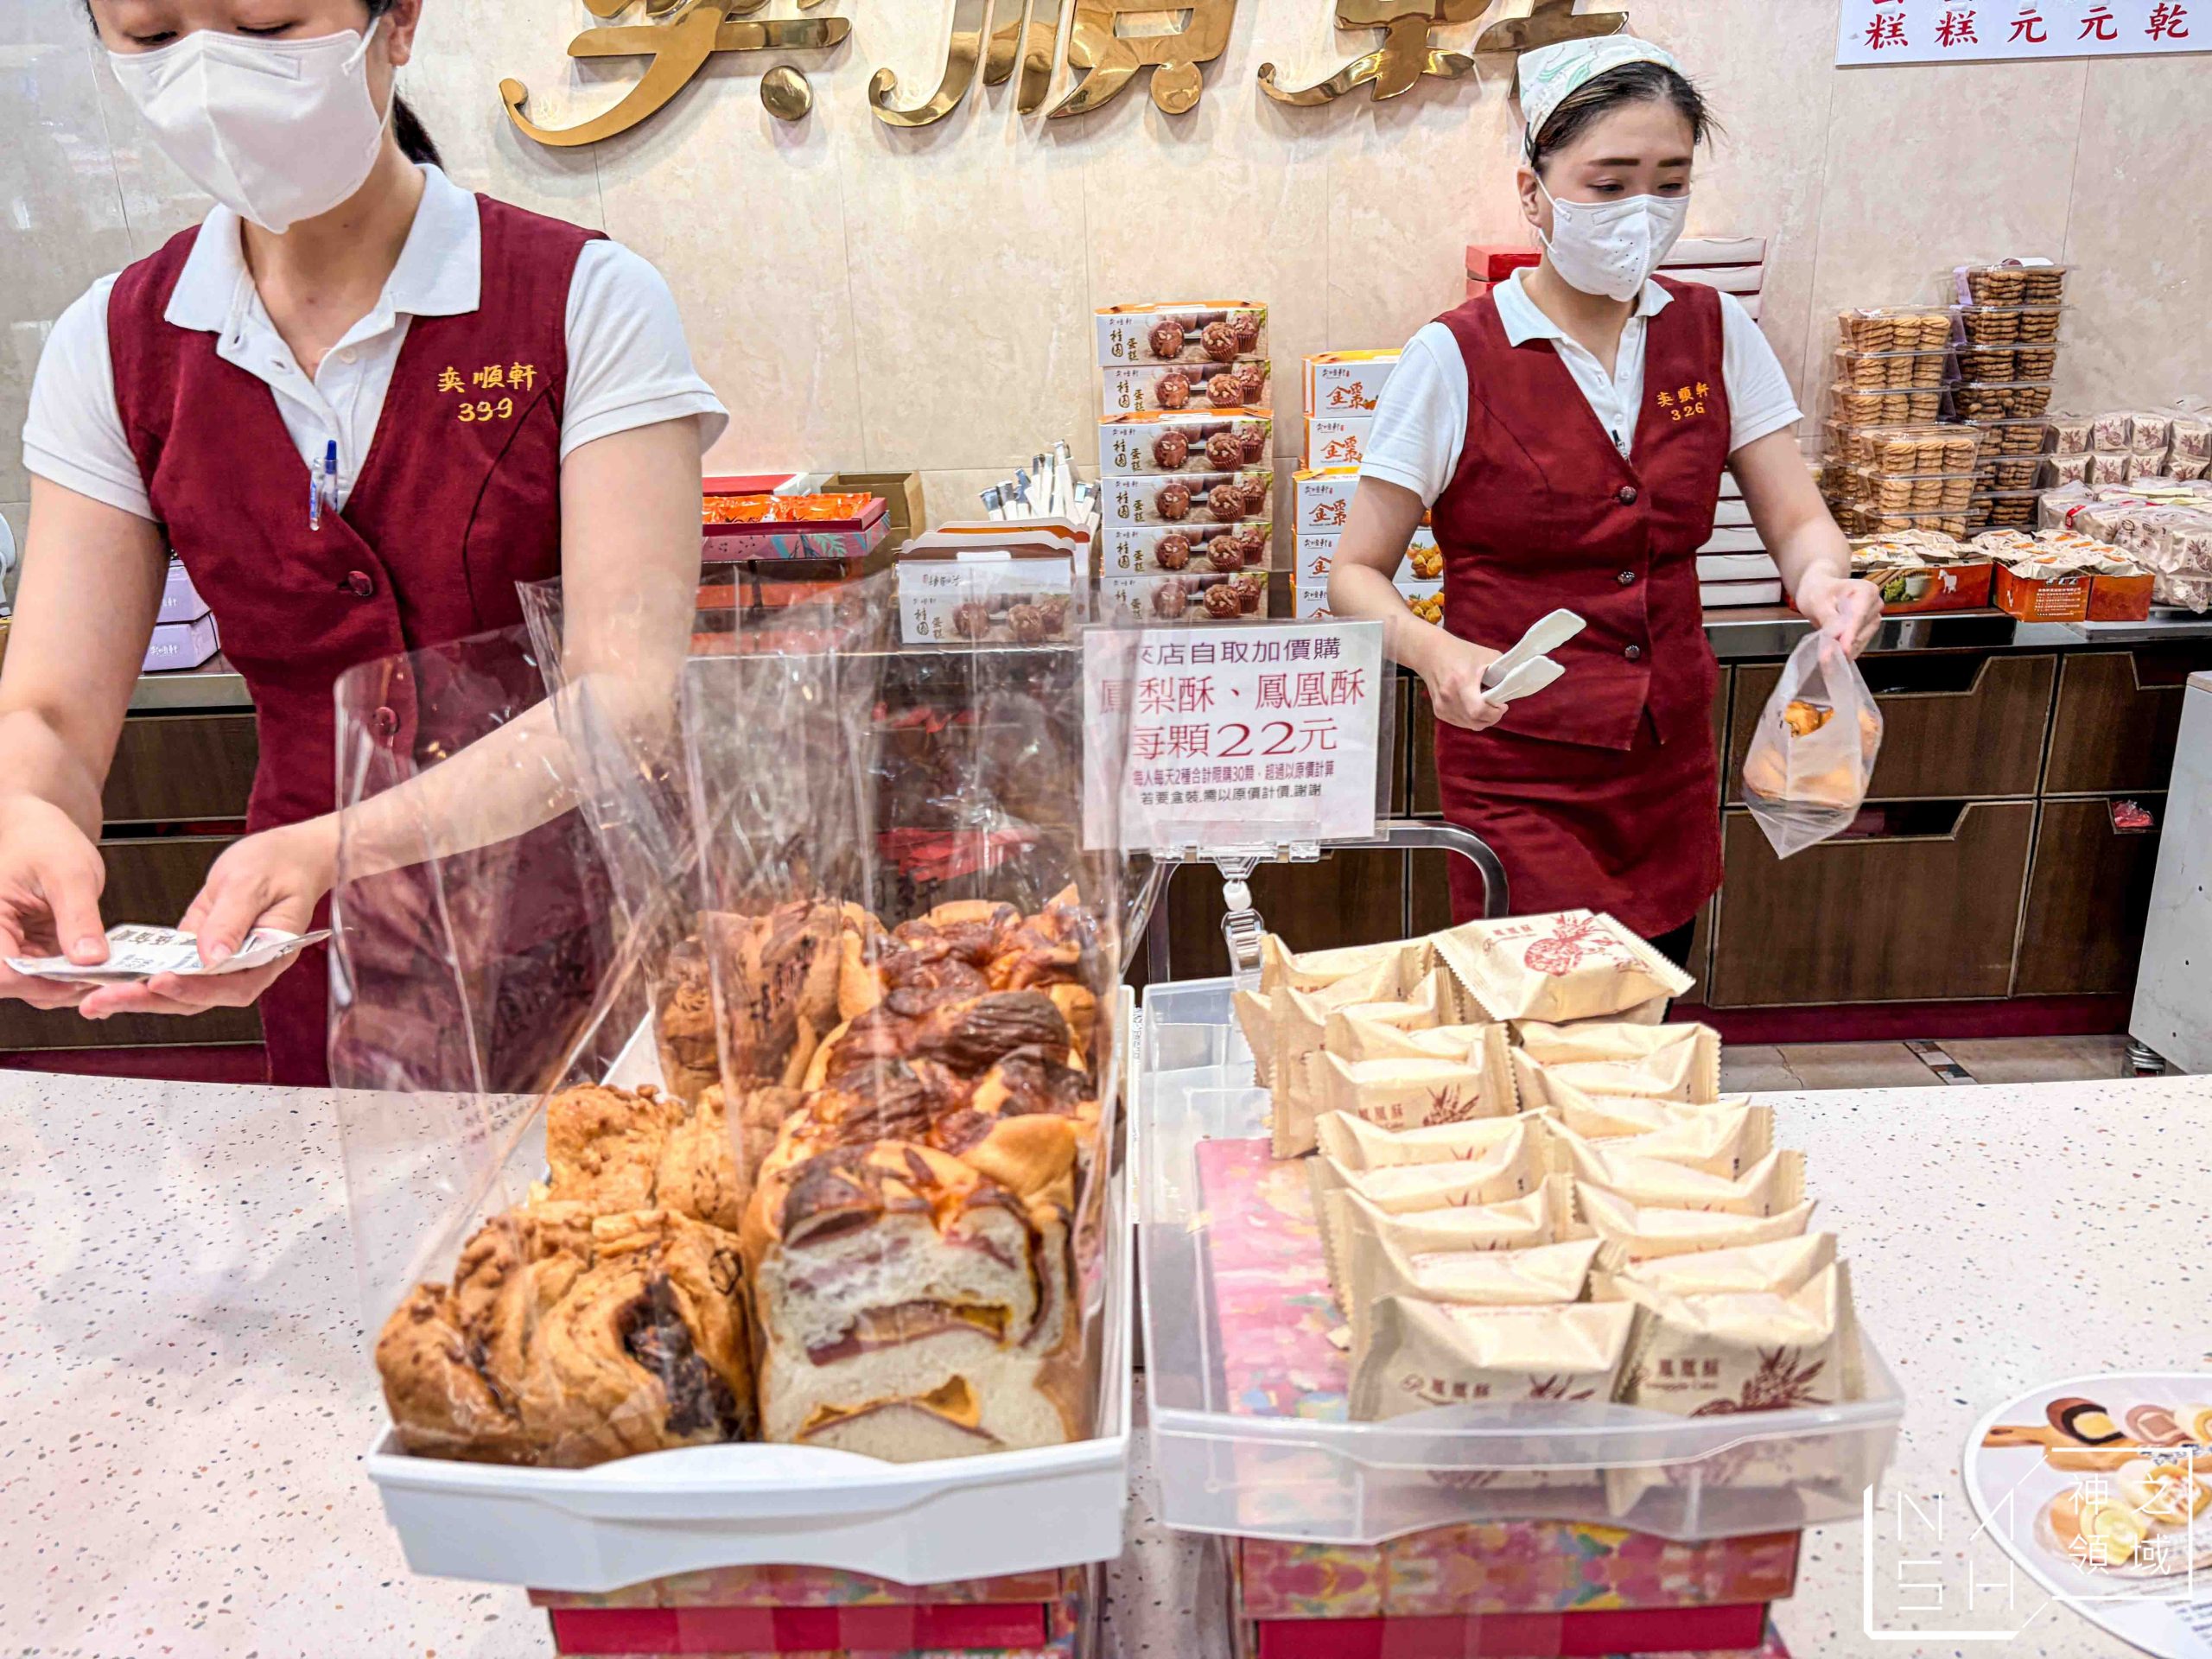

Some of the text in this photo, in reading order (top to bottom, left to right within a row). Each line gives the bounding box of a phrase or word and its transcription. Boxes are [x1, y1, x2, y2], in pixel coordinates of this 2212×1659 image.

[437, 361, 537, 393] 奕順軒
[457, 397, 513, 422] 399
[1670, 402, 1706, 421] 326
